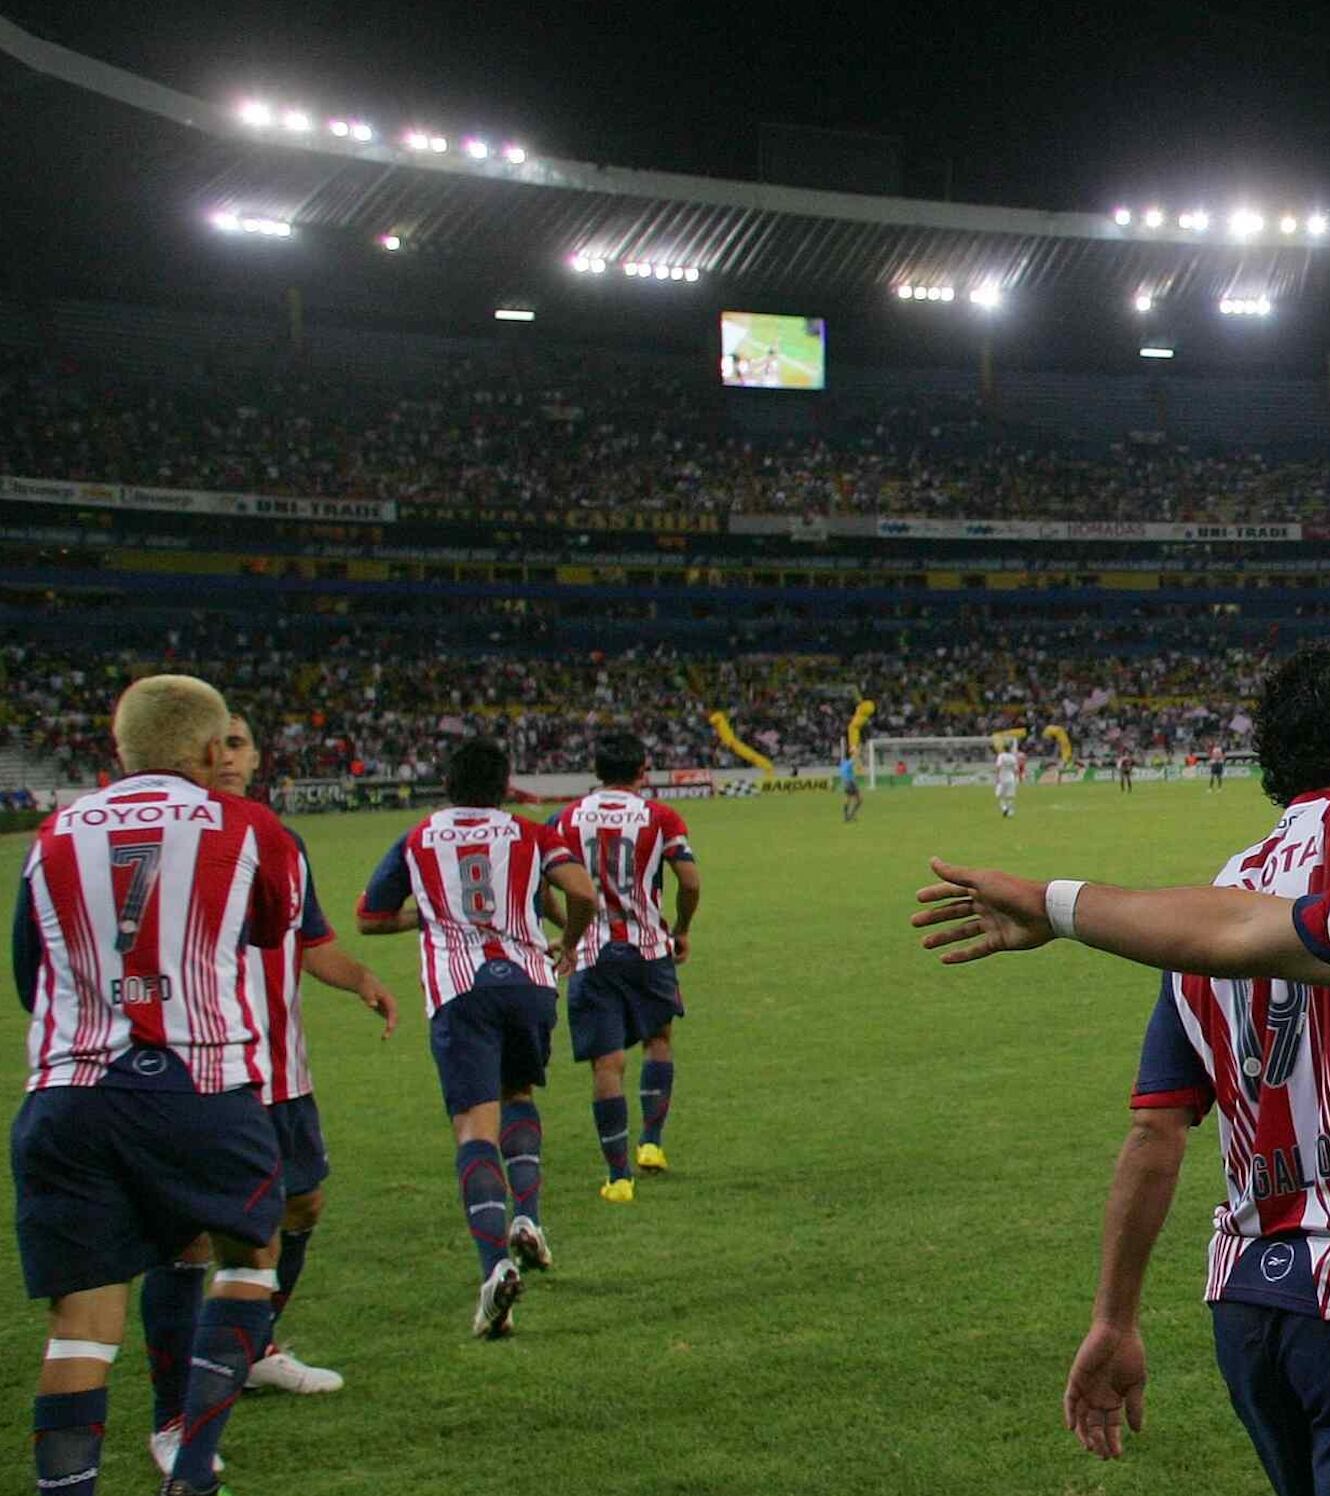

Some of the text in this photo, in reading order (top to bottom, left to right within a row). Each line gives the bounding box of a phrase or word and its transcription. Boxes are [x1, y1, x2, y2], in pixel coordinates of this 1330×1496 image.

[762, 777, 829, 792] BARDAHL
[63, 804, 215, 828] TOYOTA
[575, 810, 646, 825] TOYOTA
[425, 826, 516, 843] TOYOTA
[584, 836, 634, 895] 10
[110, 841, 162, 954] 7
[459, 853, 496, 921] 8
[111, 974, 172, 1005] BOFO
